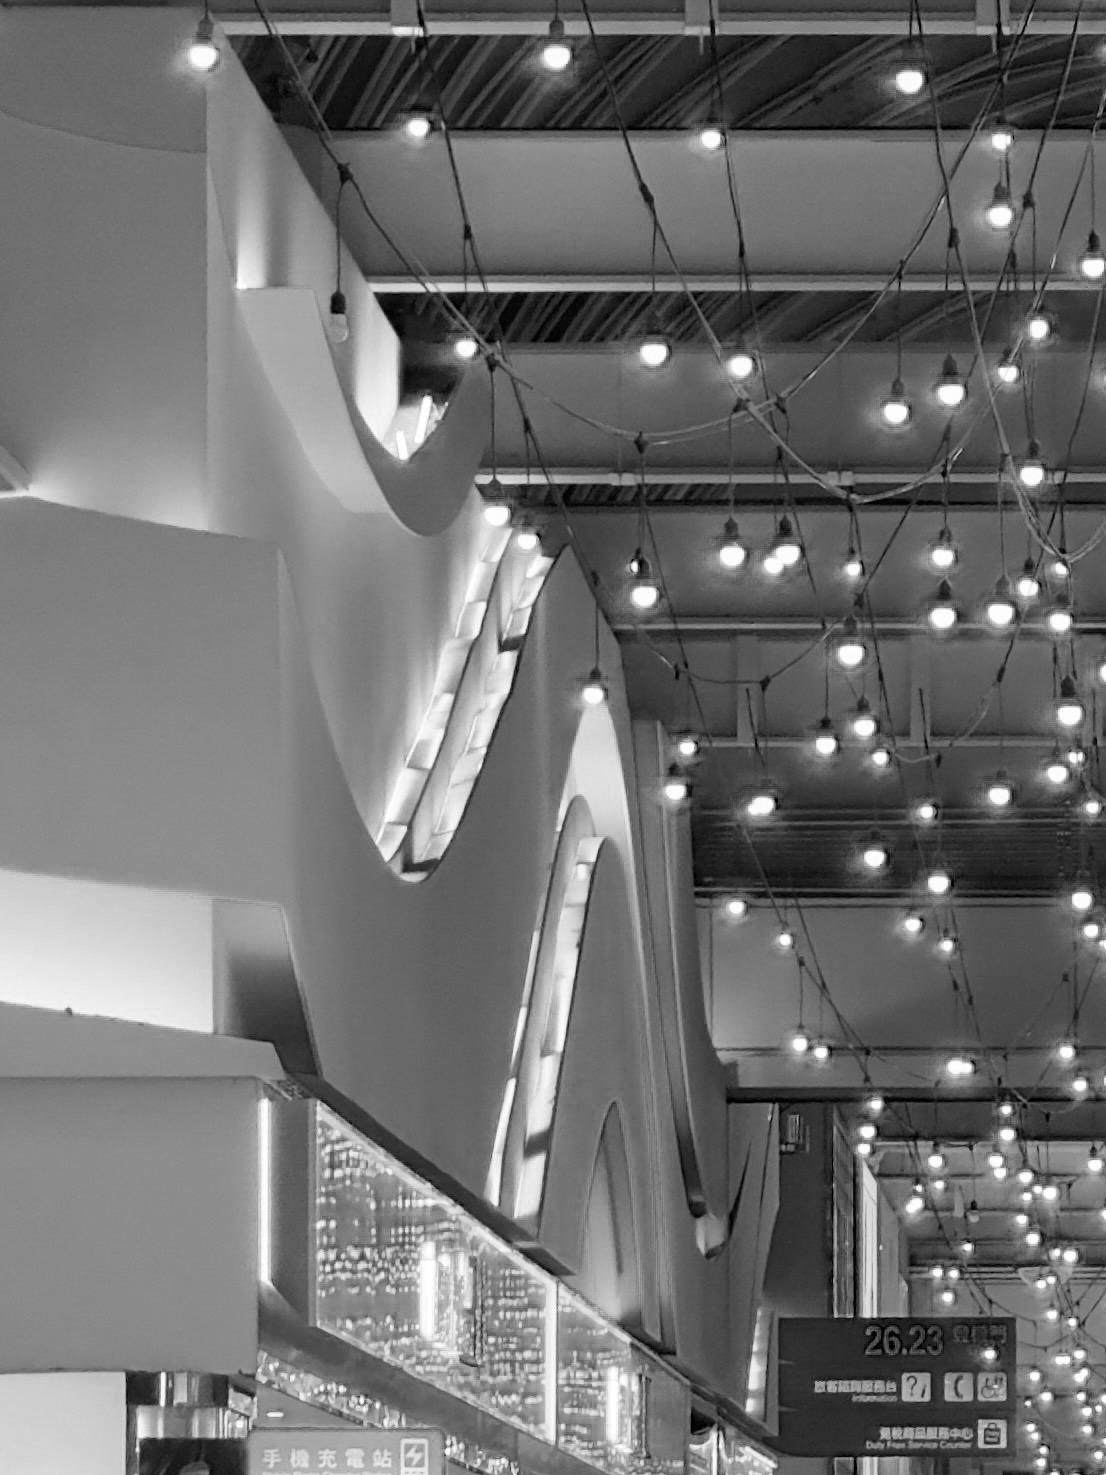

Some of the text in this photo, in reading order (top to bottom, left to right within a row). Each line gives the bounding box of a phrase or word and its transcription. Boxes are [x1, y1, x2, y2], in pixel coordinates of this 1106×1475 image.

[864, 1324, 944, 1356] 26.23
[865, 1440, 972, 1450] Duty Free Service Counter
[261, 1448, 393, 1469] 手機充電站
